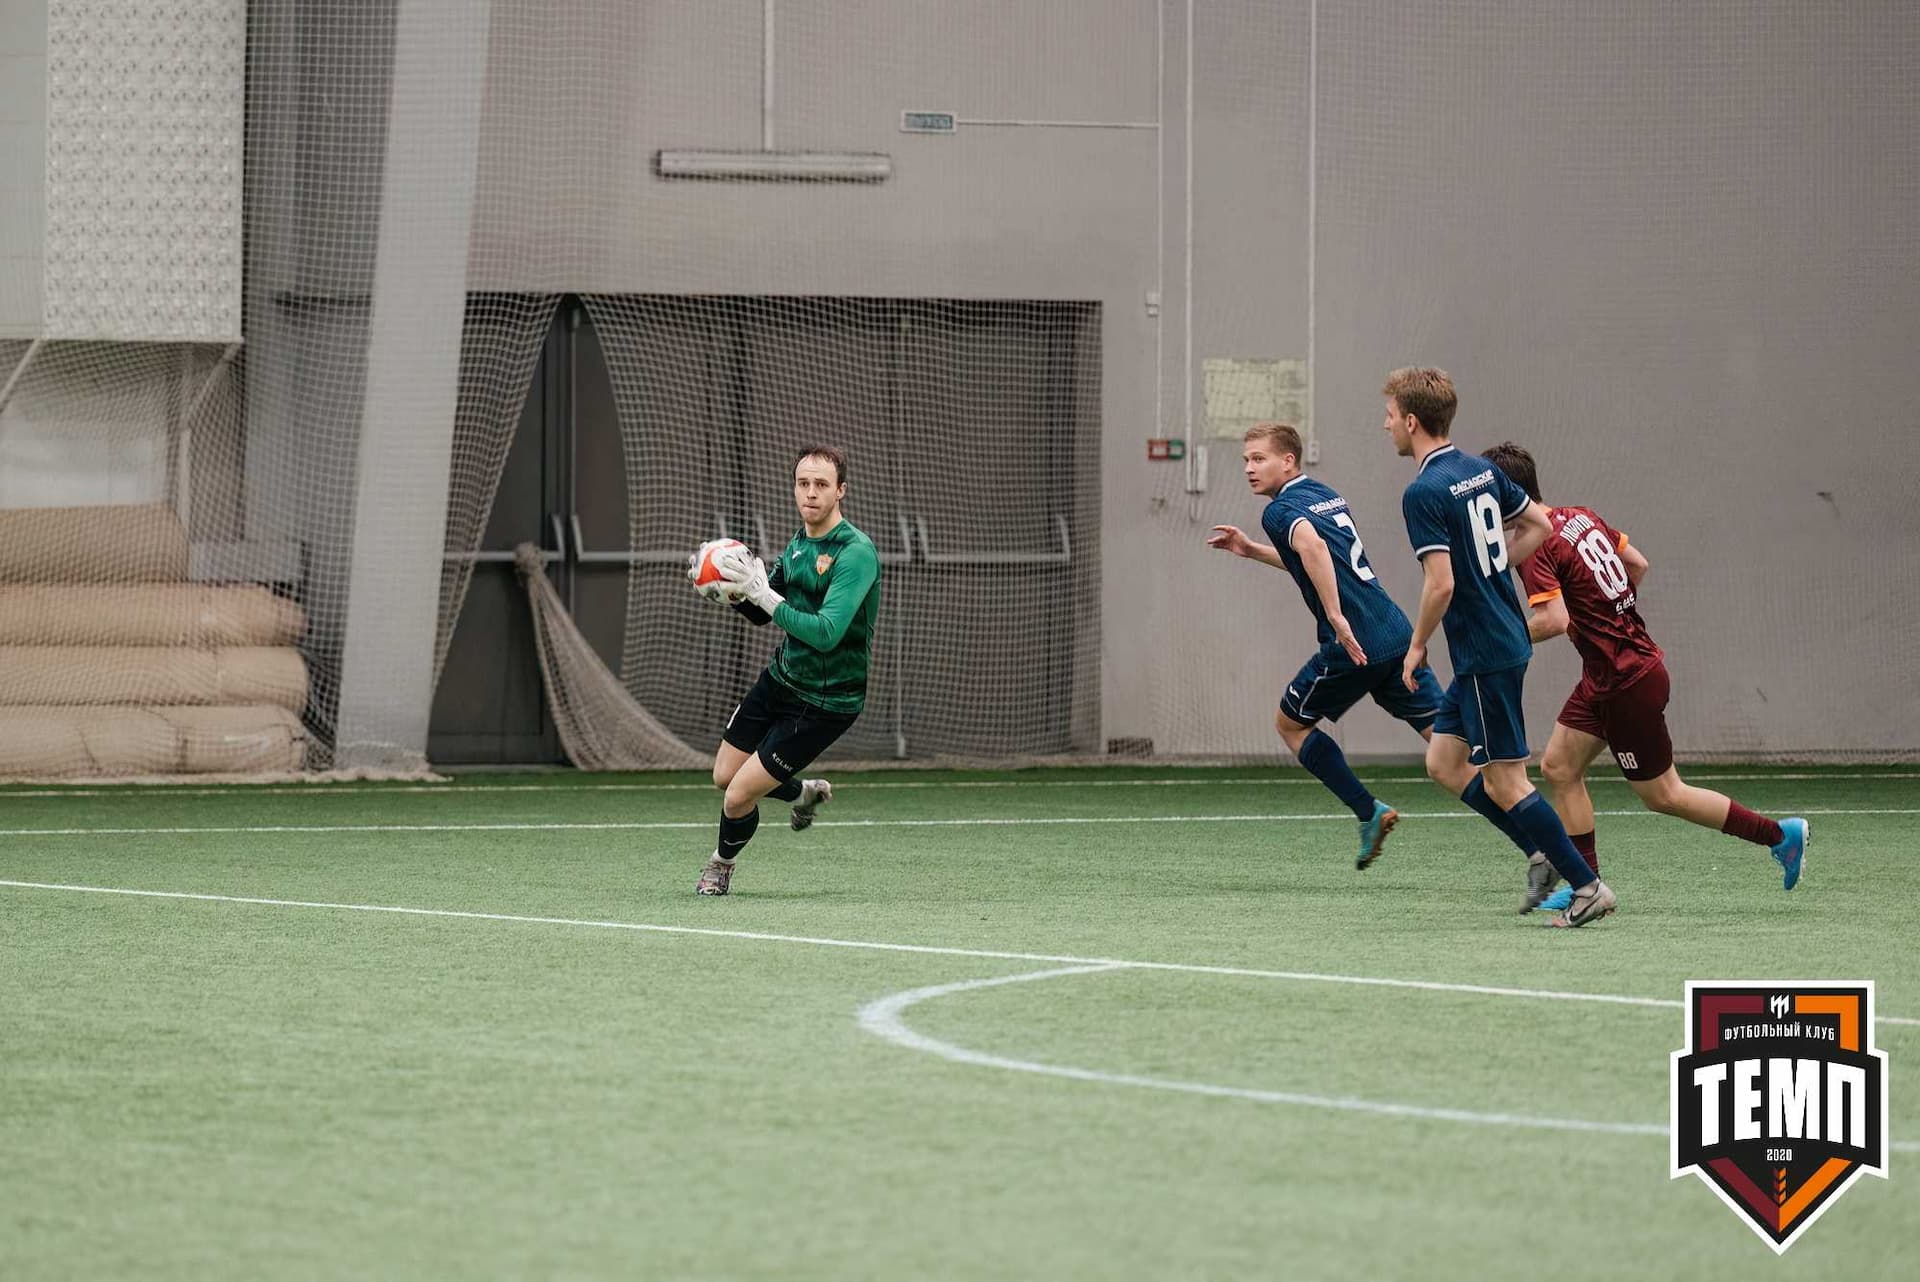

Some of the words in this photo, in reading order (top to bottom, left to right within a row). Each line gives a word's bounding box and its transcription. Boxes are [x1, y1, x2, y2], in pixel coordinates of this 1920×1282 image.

[1332, 512, 1376, 581] 2
[1467, 492, 1509, 579] 19
[1577, 528, 1629, 600] 88
[1617, 751, 1639, 769] 88
